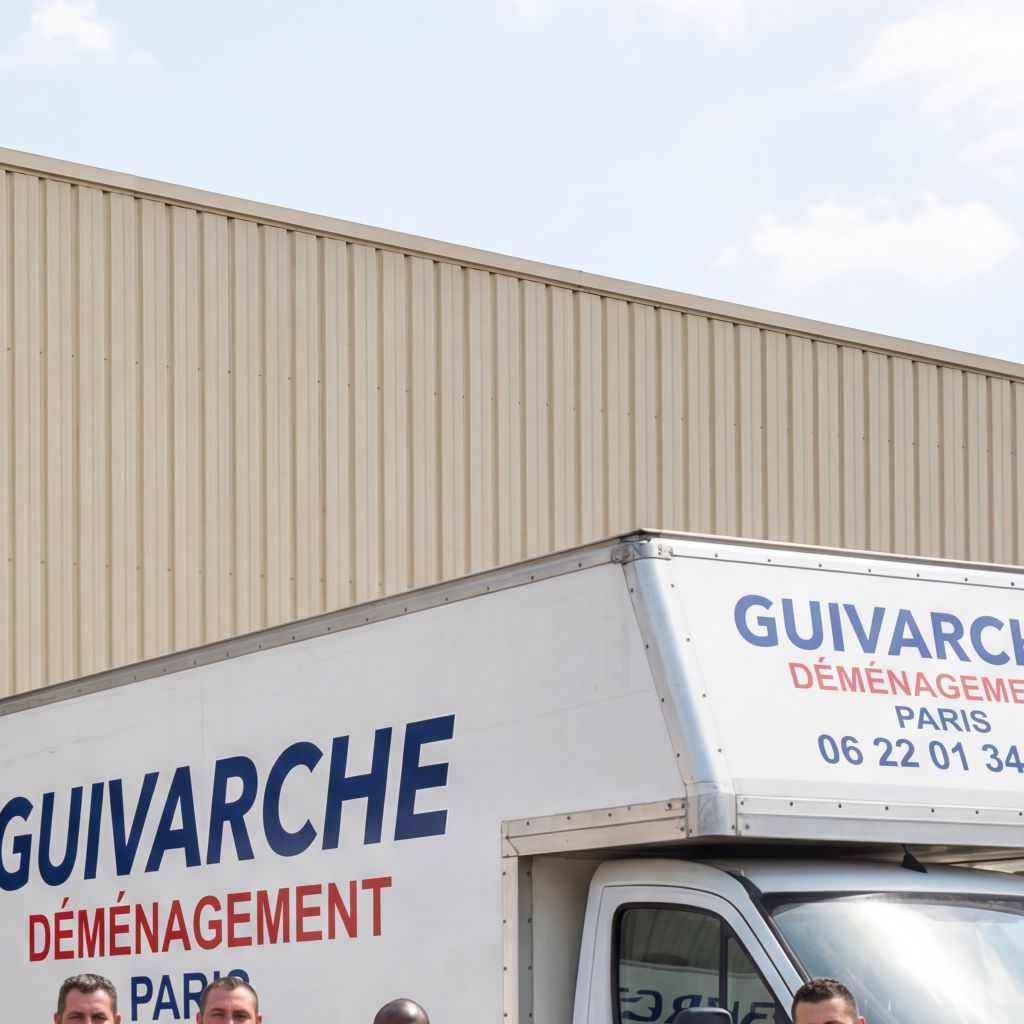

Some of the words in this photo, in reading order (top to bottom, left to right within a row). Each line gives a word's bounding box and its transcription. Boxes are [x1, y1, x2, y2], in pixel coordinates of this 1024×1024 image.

[894, 704, 992, 734] PARIS
[817, 733, 864, 766] 06
[872, 736, 921, 769] 22
[928, 739, 970, 772] 01
[981, 743, 1024, 774] 34
[28, 876, 393, 963] DÉMÉNAGEMENT
[130, 968, 250, 1021] PAR
